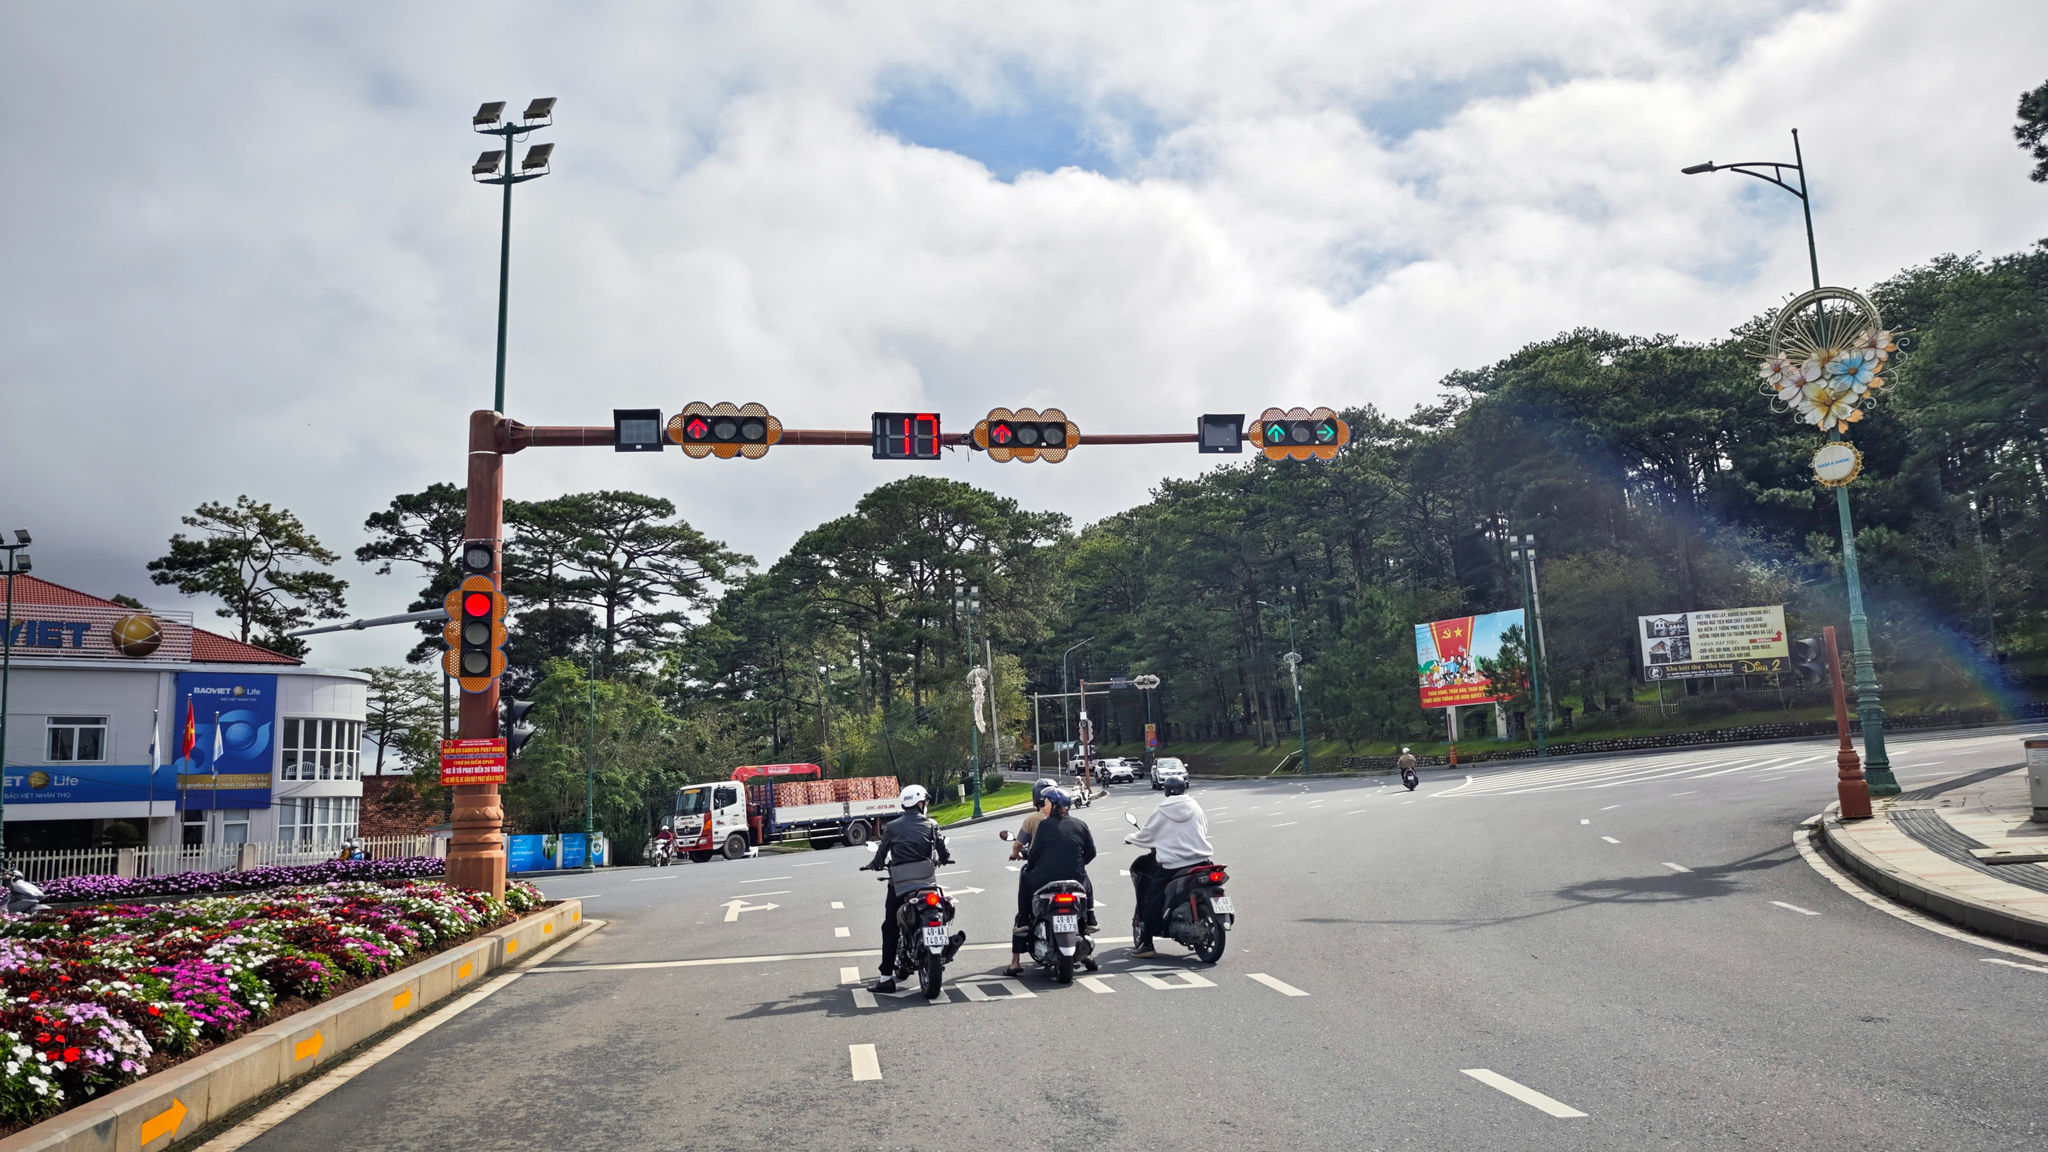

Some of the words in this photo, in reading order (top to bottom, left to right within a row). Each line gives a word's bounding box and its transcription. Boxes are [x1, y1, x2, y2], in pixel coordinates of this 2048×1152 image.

[904, 413, 938, 456] 17
[194, 687, 231, 695] BAOVIET
[54, 775, 79, 786] Life
